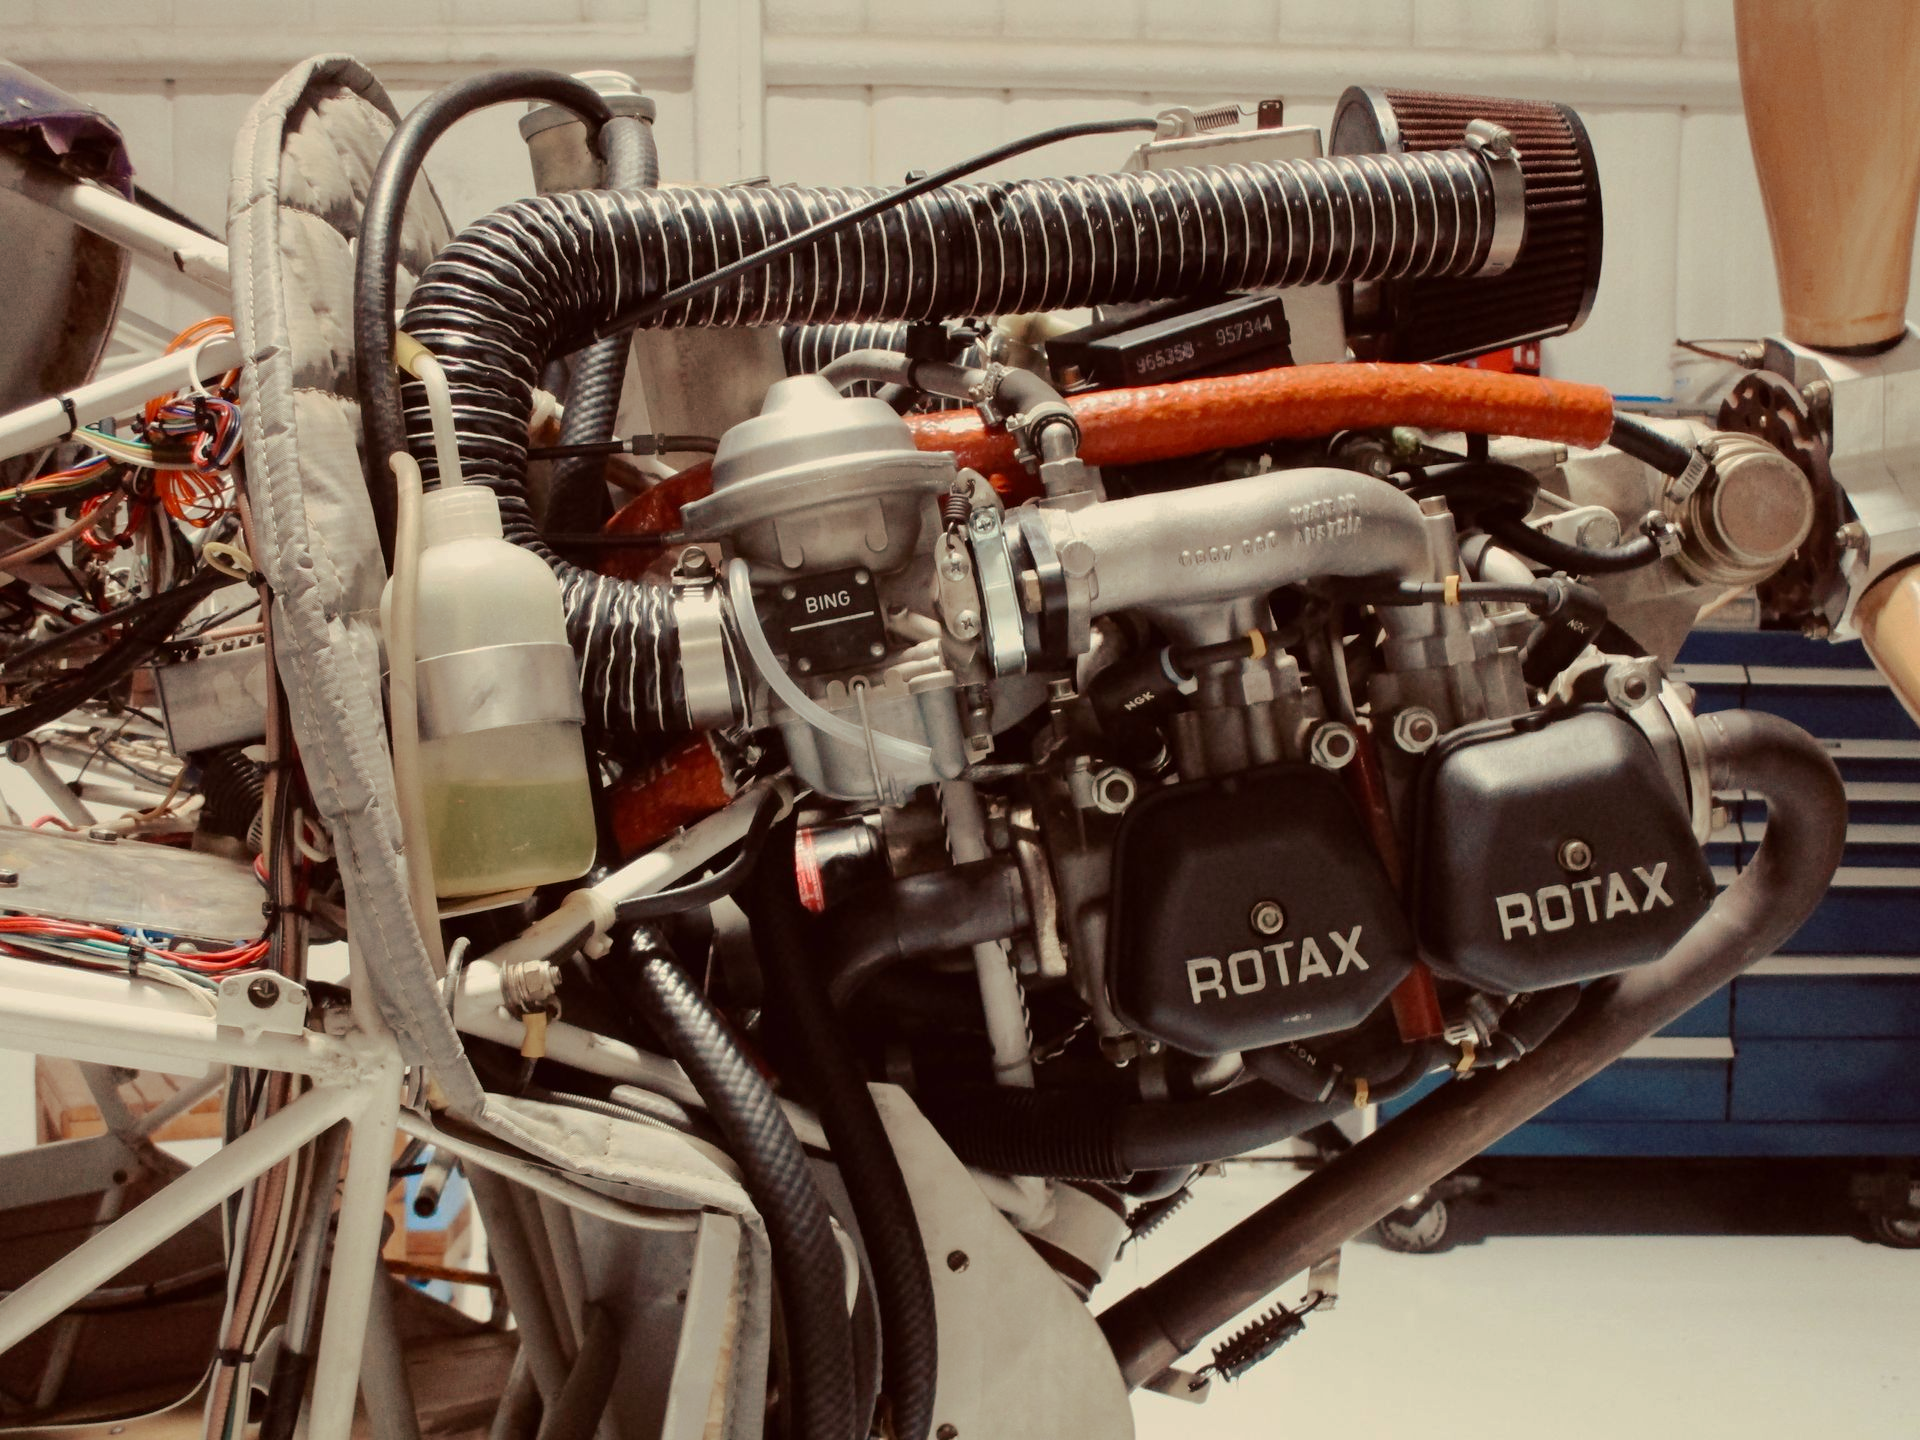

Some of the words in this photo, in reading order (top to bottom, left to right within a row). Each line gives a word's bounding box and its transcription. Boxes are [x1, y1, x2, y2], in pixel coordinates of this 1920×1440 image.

[1216, 313, 1273, 346] 957344
[805, 590, 851, 613] BING
[1124, 691, 1155, 711] NGK
[1496, 861, 1674, 941] ROTAX
[1185, 924, 1370, 1004] ROTAX
